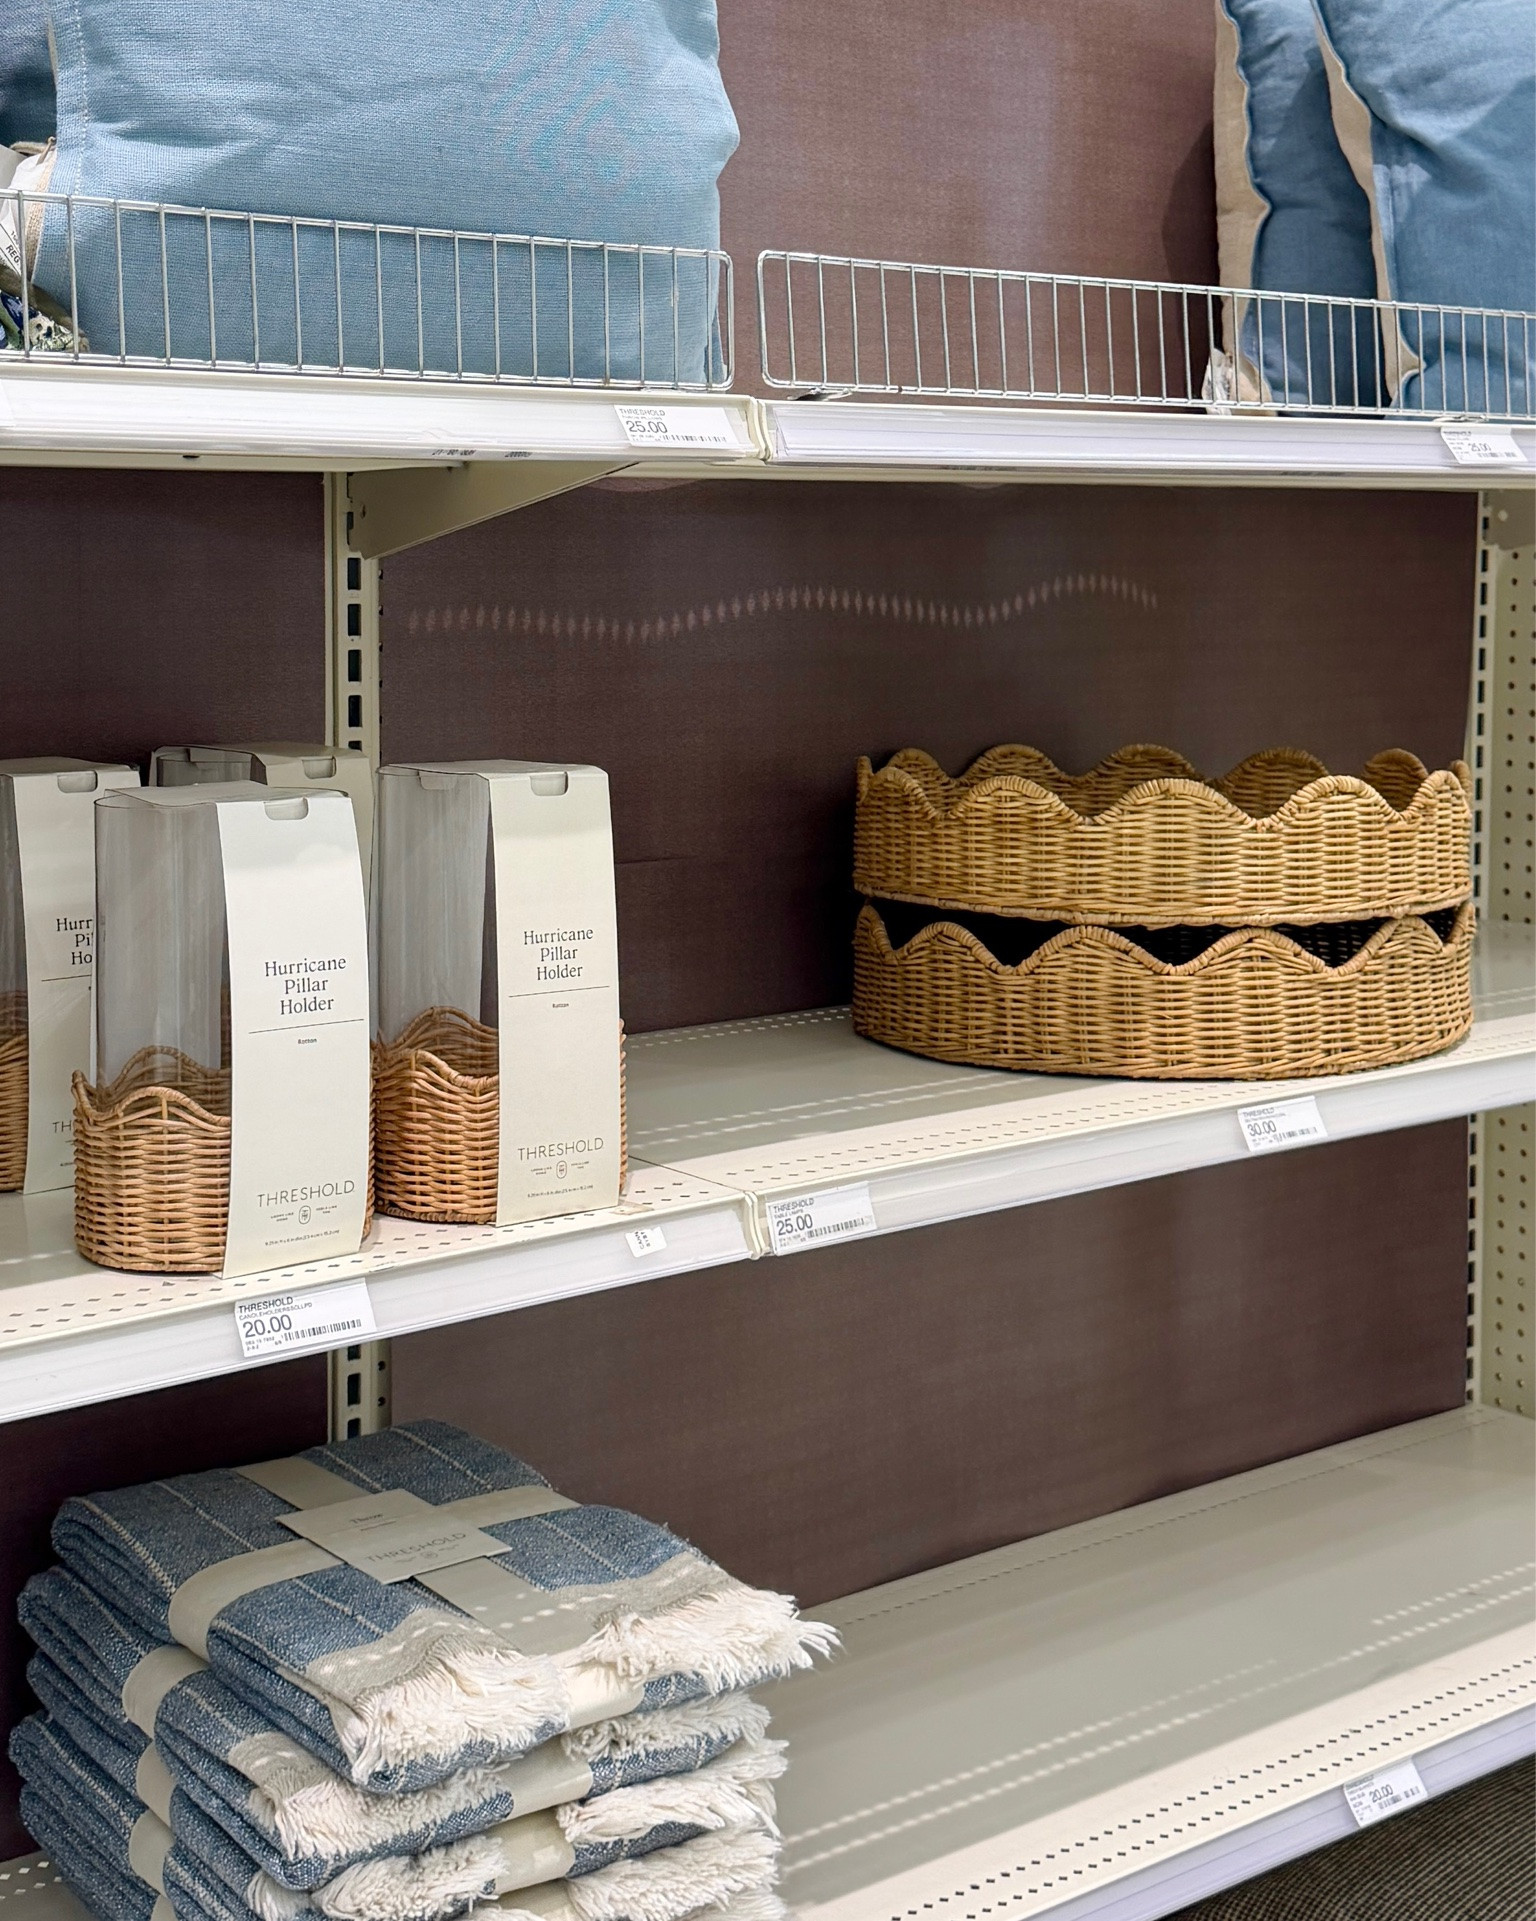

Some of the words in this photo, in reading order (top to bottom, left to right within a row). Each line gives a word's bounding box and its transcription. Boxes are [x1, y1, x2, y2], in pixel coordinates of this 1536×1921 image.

[618, 408, 666, 417] THRESHOLD
[625, 420, 668, 434] 25.00
[523, 927, 594, 945] Hurricane
[540, 945, 578, 962] Pillar
[264, 957, 347, 977] Hurricane
[536, 963, 583, 981] Holder
[284, 977, 329, 995] Pillar
[280, 996, 335, 1016] Holder
[1247, 1120, 1277, 1137] 30.00
[517, 1137, 604, 1161] THRESHOLD
[257, 1180, 355, 1207] THRESHOLD
[773, 1197, 815, 1214] THRESHOLD
[776, 1213, 813, 1236] 25.00
[238, 1296, 294, 1314] THRESHOLD
[242, 1314, 292, 1338] 20.00
[1369, 1784, 1394, 1803] 20.00
